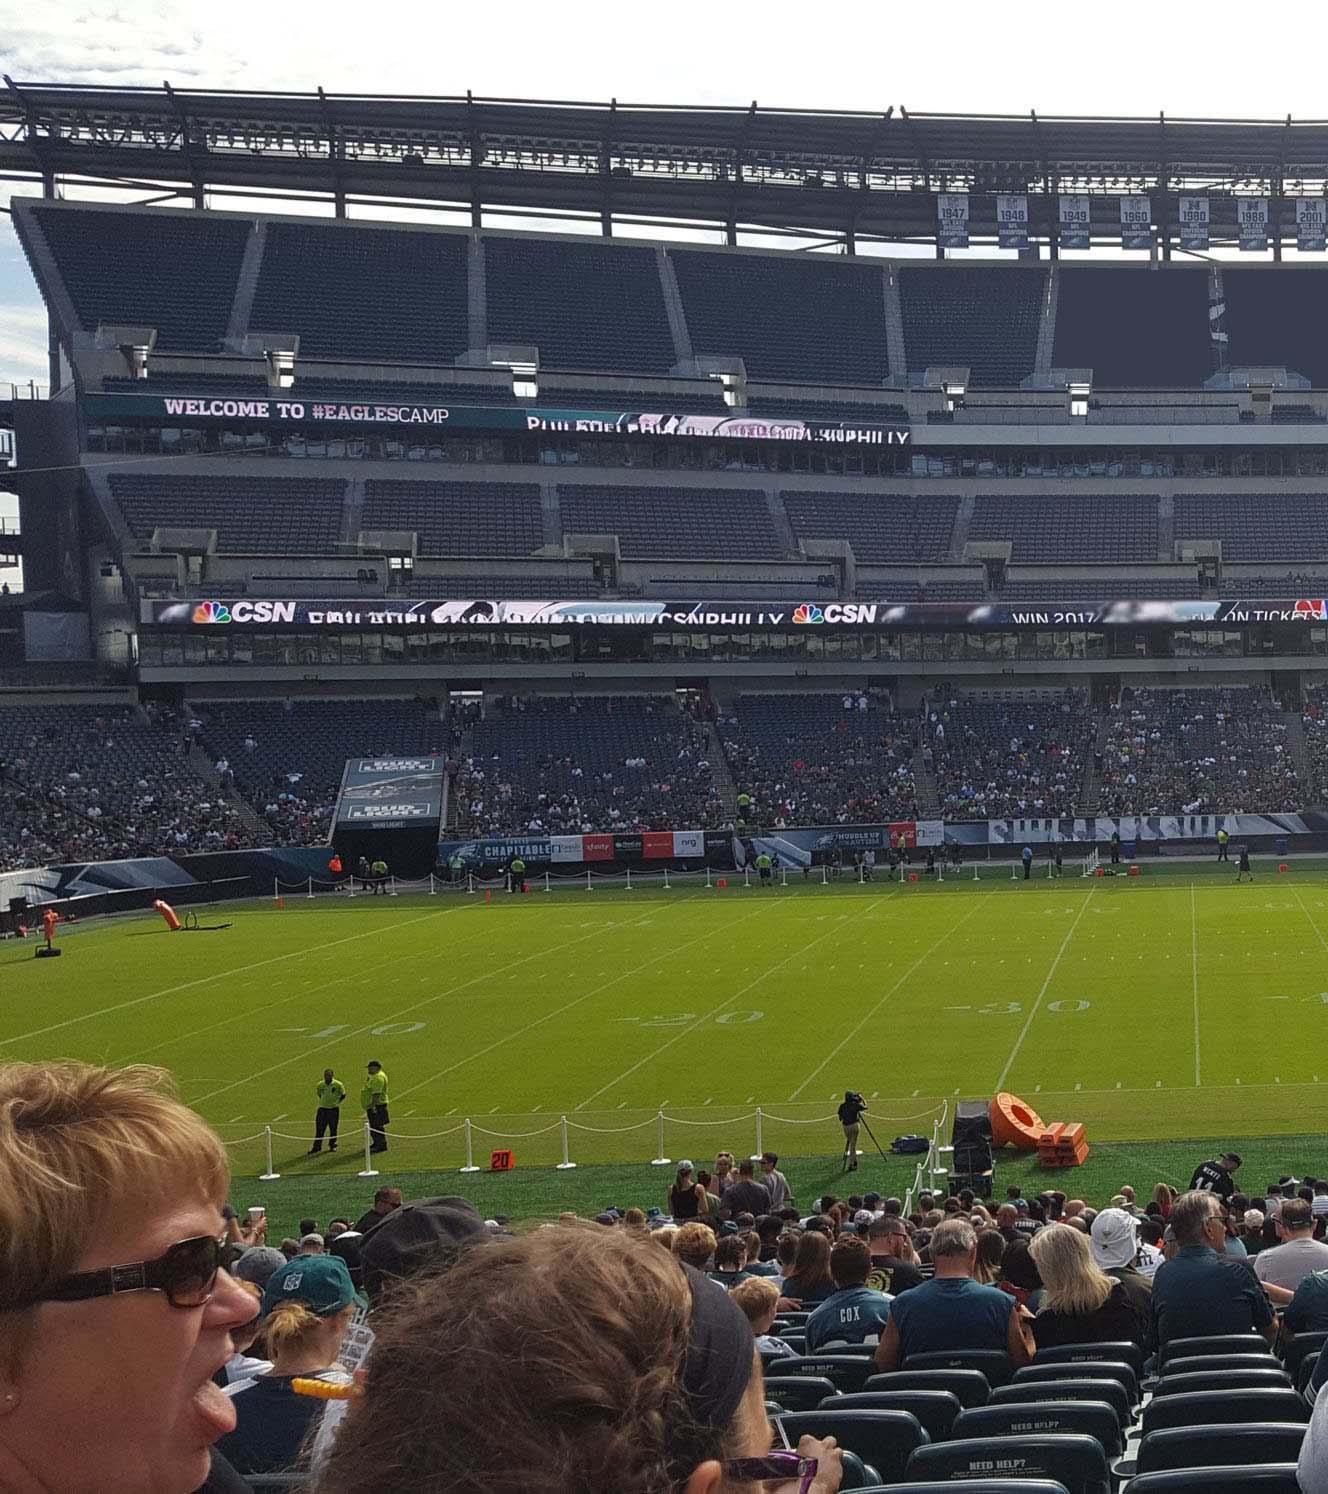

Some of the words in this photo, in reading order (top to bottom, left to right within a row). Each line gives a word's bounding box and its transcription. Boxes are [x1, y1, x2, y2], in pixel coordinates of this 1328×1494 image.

[942, 208, 964, 218] 1947
[1001, 210, 1024, 220] 1948
[1063, 211, 1086, 221] 1949
[1300, 212, 1322, 222] 2001
[164, 399, 269, 417] WELCOME
[277, 403, 304, 417] TO
[312, 405, 449, 423] #EAGLESCAMP
[231, 602, 296, 623] CSN
[824, 605, 876, 623] CSN
[681, 839, 696, 847] nrg
[485, 844, 551, 857] CHARITABLE
[492, 1153, 508, 1168] 20
[840, 1306, 860, 1323] COX
[1011, 1423, 1032, 1431] NEED
[1035, 1421, 1059, 1430] HELP?
[970, 1461, 993, 1470] NEED
[997, 1460, 1026, 1469] HELP?
